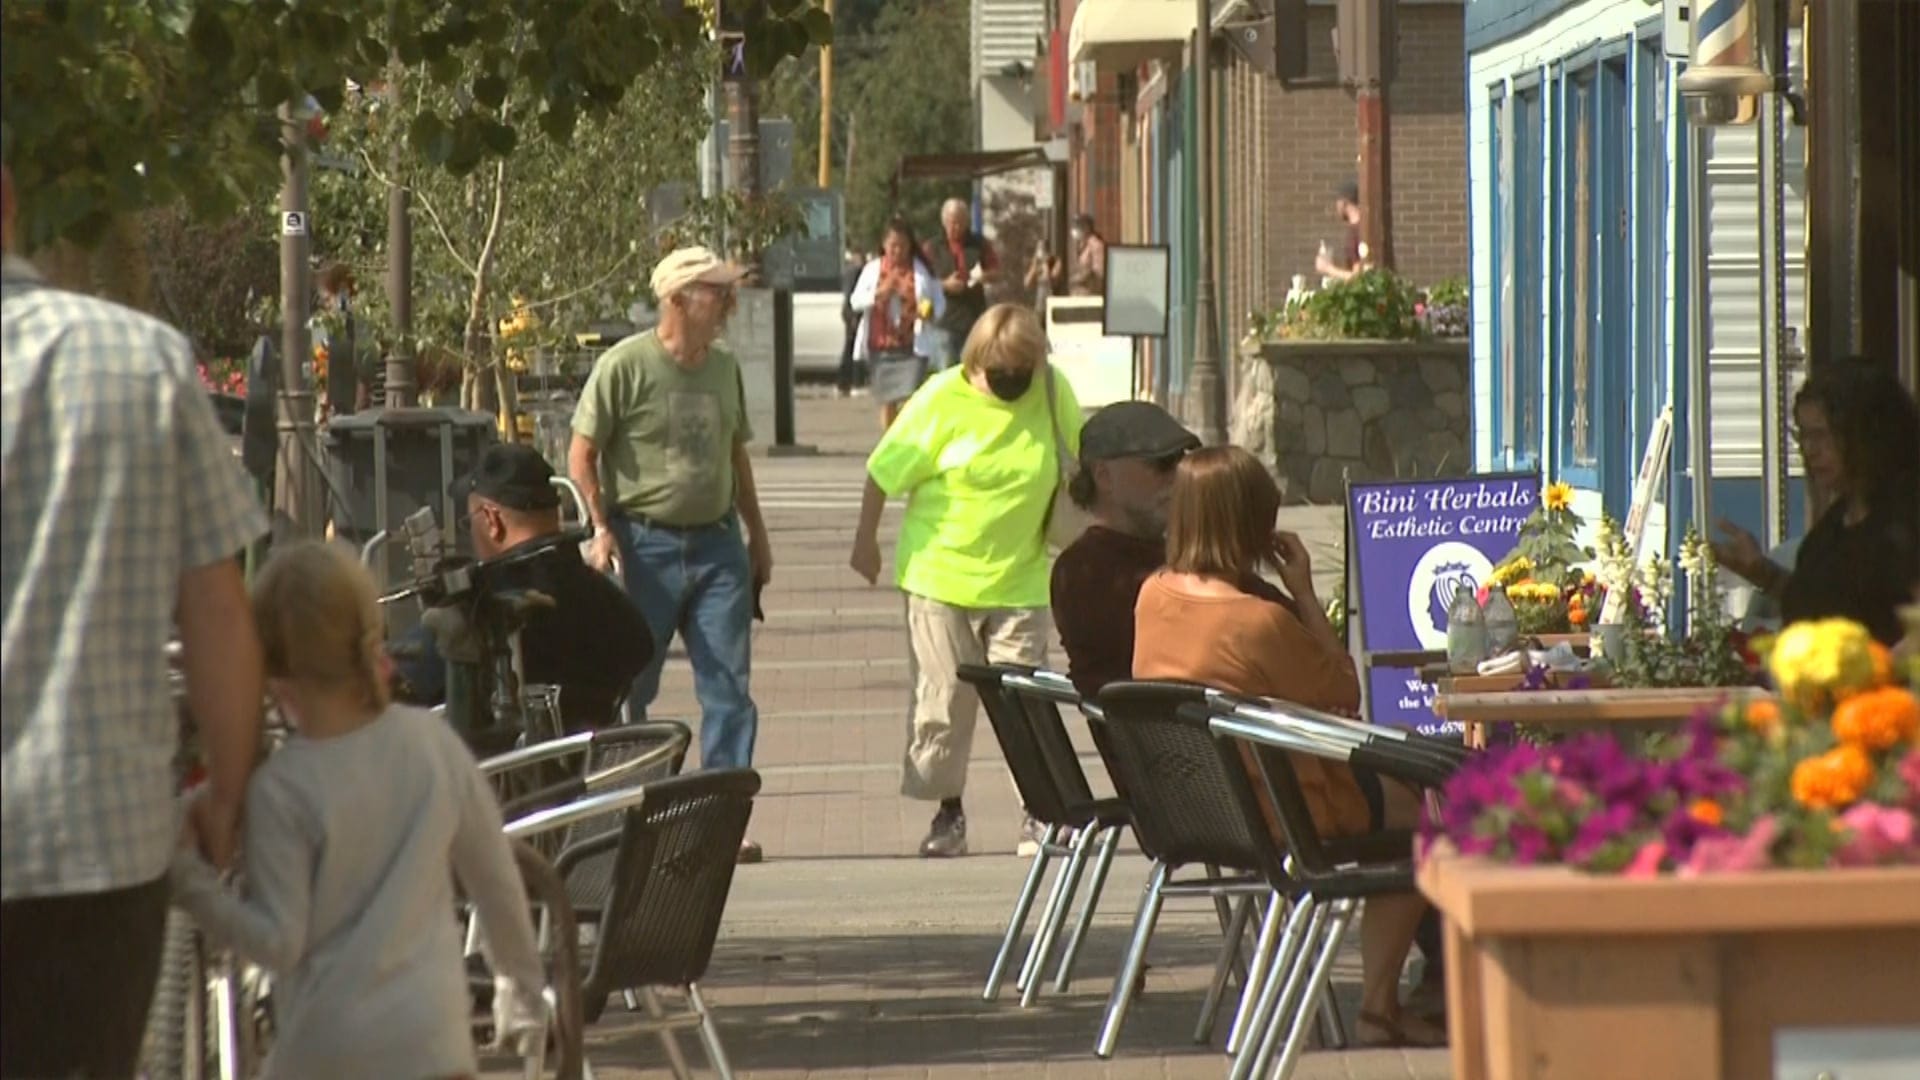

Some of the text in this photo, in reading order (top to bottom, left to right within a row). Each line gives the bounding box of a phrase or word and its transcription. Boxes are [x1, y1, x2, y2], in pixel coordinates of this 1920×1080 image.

[1358, 481, 1534, 513] Bini Herbals
[1368, 514, 1527, 539] Esthetic Centre
[1405, 680, 1428, 693] We
[1399, 695, 1421, 709] the
